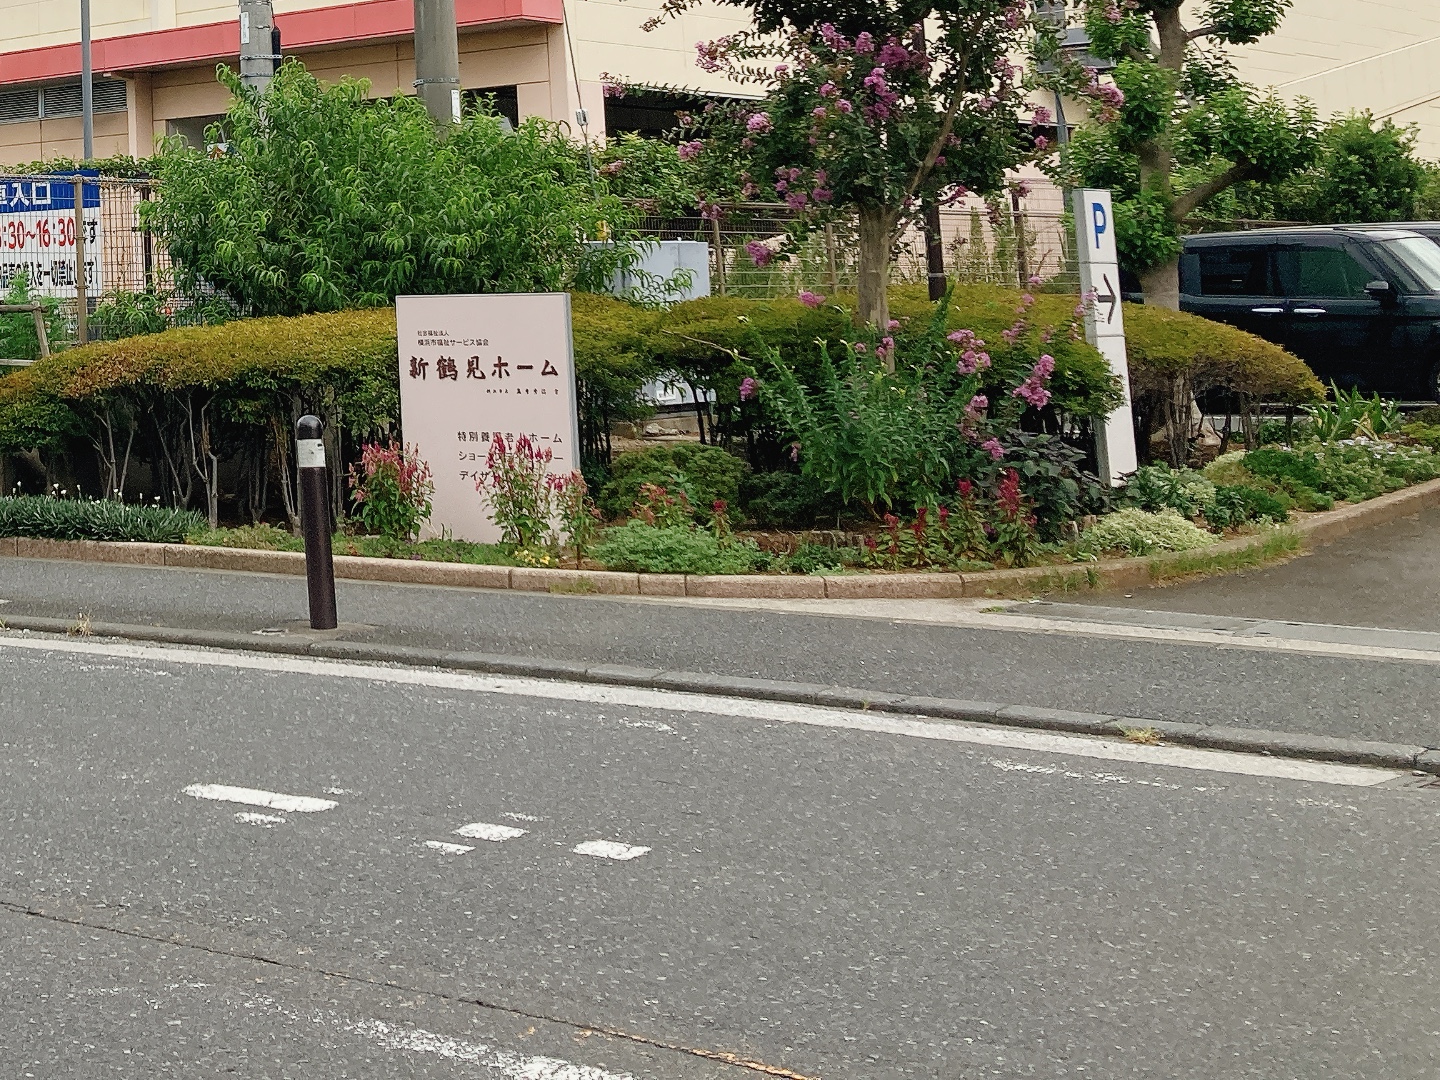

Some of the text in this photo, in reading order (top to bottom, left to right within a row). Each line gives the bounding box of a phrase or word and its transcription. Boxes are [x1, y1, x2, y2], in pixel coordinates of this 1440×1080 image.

[1092, 202, 1107, 249] P
[409, 355, 559, 381] 新鶴見ホーム
[457, 431, 563, 444] 特別養老ホーム
